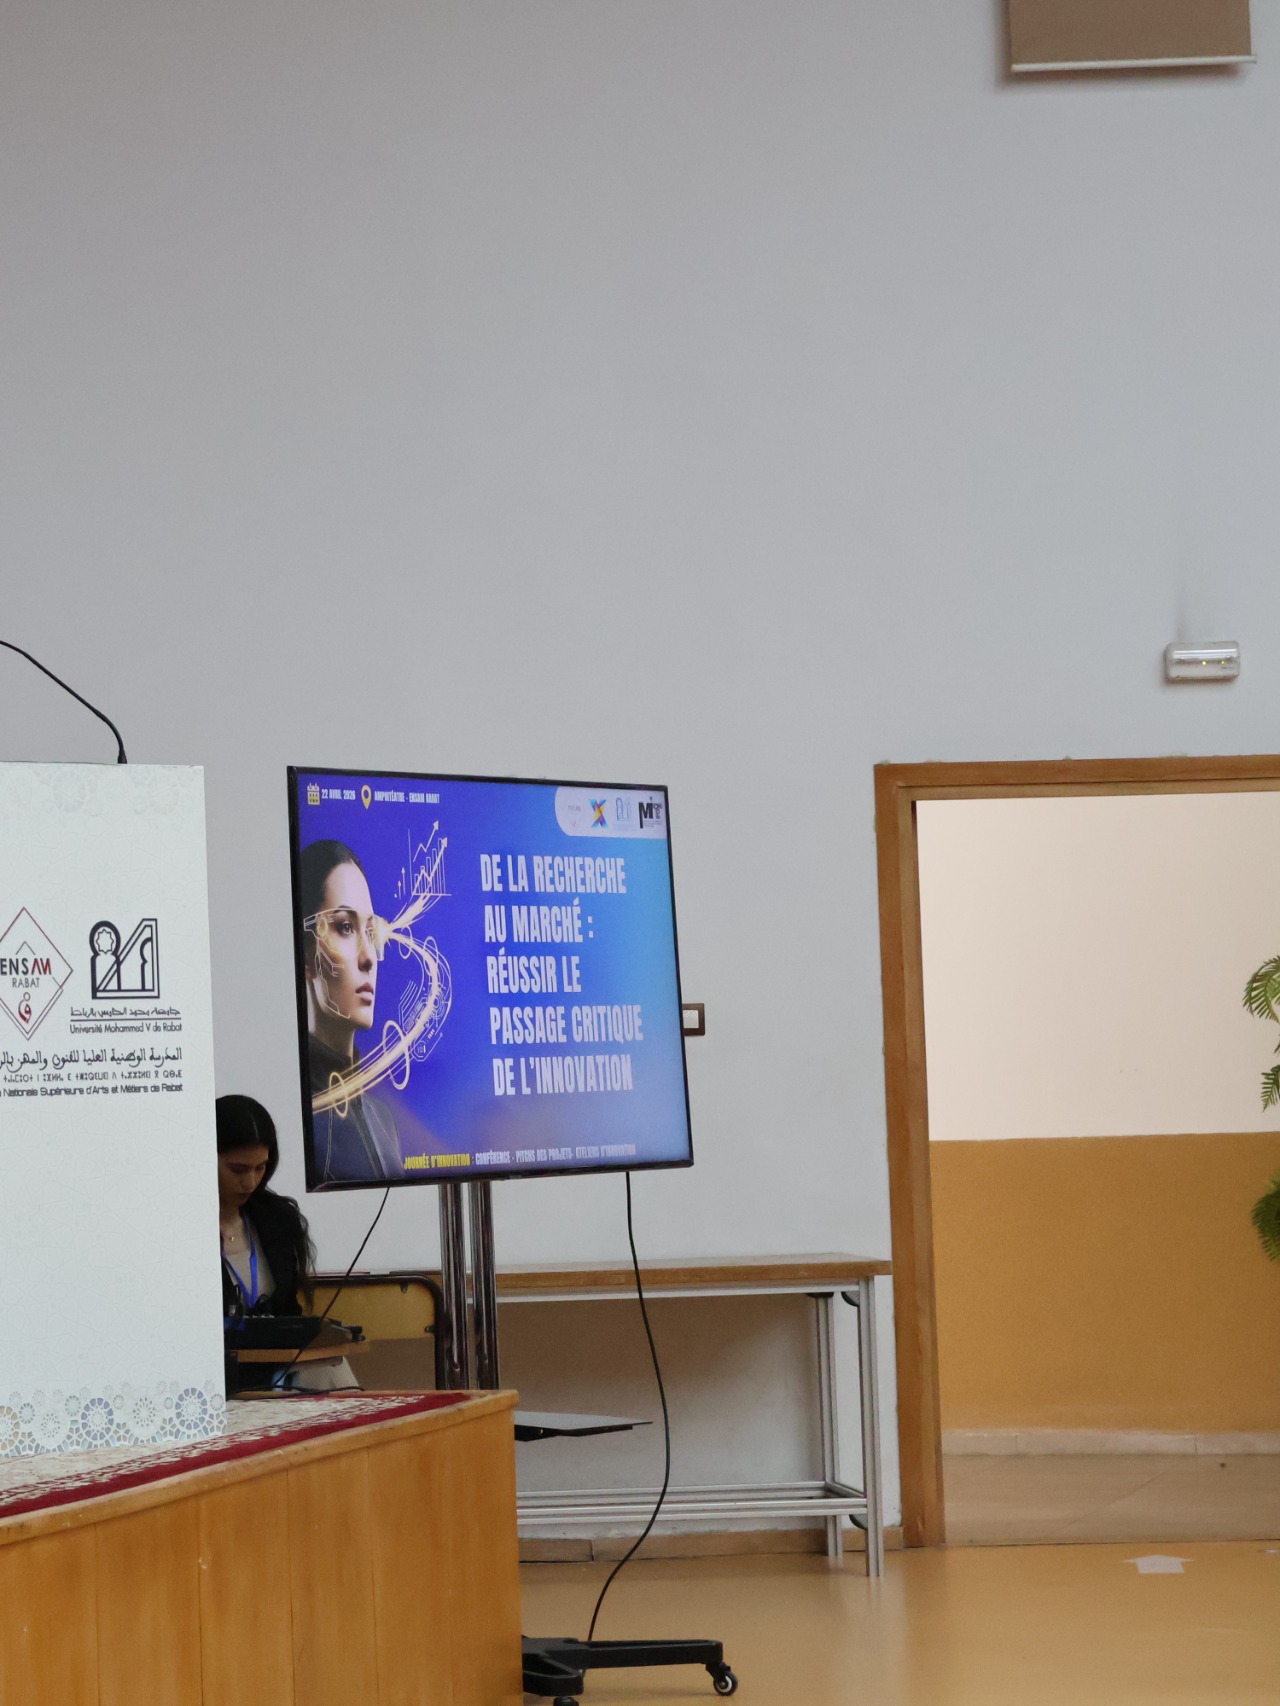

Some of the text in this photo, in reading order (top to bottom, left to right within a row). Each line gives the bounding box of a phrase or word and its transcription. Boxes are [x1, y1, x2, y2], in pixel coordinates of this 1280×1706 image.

[480, 854, 627, 894] DE LA RECHERCHE
[484, 905, 507, 943] AU
[512, 897, 584, 943] MARCHÉ
[0, 957, 52, 976] ENSAM
[487, 947, 582, 994] RÉUSSIR LE
[12, 977, 40, 988] RABAT
[129, 1008, 150, 1017] محمد
[70, 1022, 182, 1034] Université Mohammed V de Rabat
[489, 1005, 644, 1045] PASSAGE CRITIQUE
[52, 1049, 80, 1070] للفنون
[82, 1048, 107, 1065] العليا
[110, 1047, 146, 1068] الوطنية
[149, 1047, 182, 1068] المدرسة
[493, 1058, 516, 1096] DE
[3, 1087, 38, 1097] Nationale
[40, 1086, 84, 1097] Supérieure
[111, 1085, 118, 1093] et
[120, 1084, 148, 1093] Métiers
[150, 1083, 159, 1092] de
[161, 1082, 183, 1092] Rabat
[403, 1152, 430, 1170] JOURNÉE
[475, 1149, 511, 1166] CONFÉRENCE
